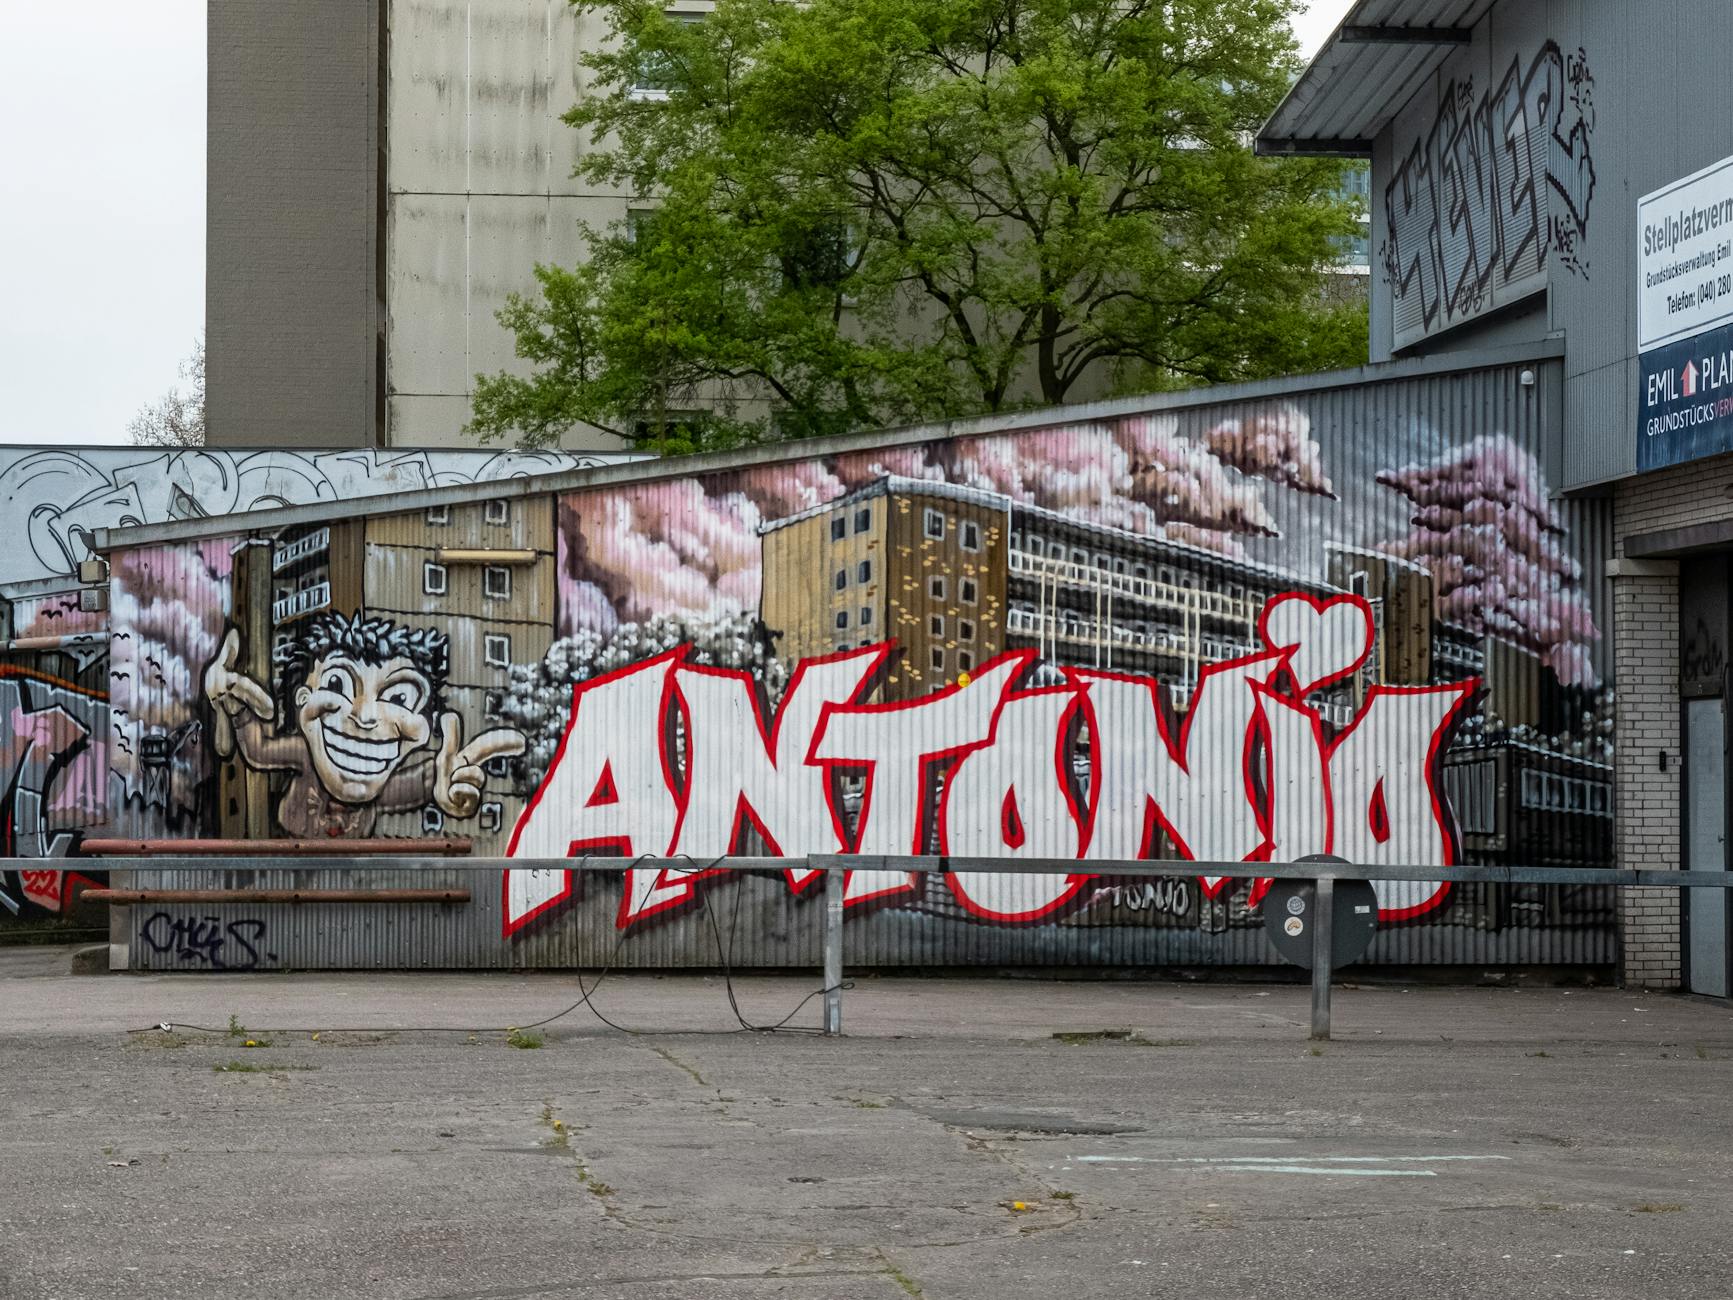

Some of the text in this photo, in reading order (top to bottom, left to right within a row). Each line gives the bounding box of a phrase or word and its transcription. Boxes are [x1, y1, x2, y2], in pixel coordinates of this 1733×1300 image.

[1646, 239, 1732, 288] Grundstücksverwaltung Emil
[1667, 273, 1732, 315] Telefon: (040) 280
[1647, 367, 1679, 407] EMIL
